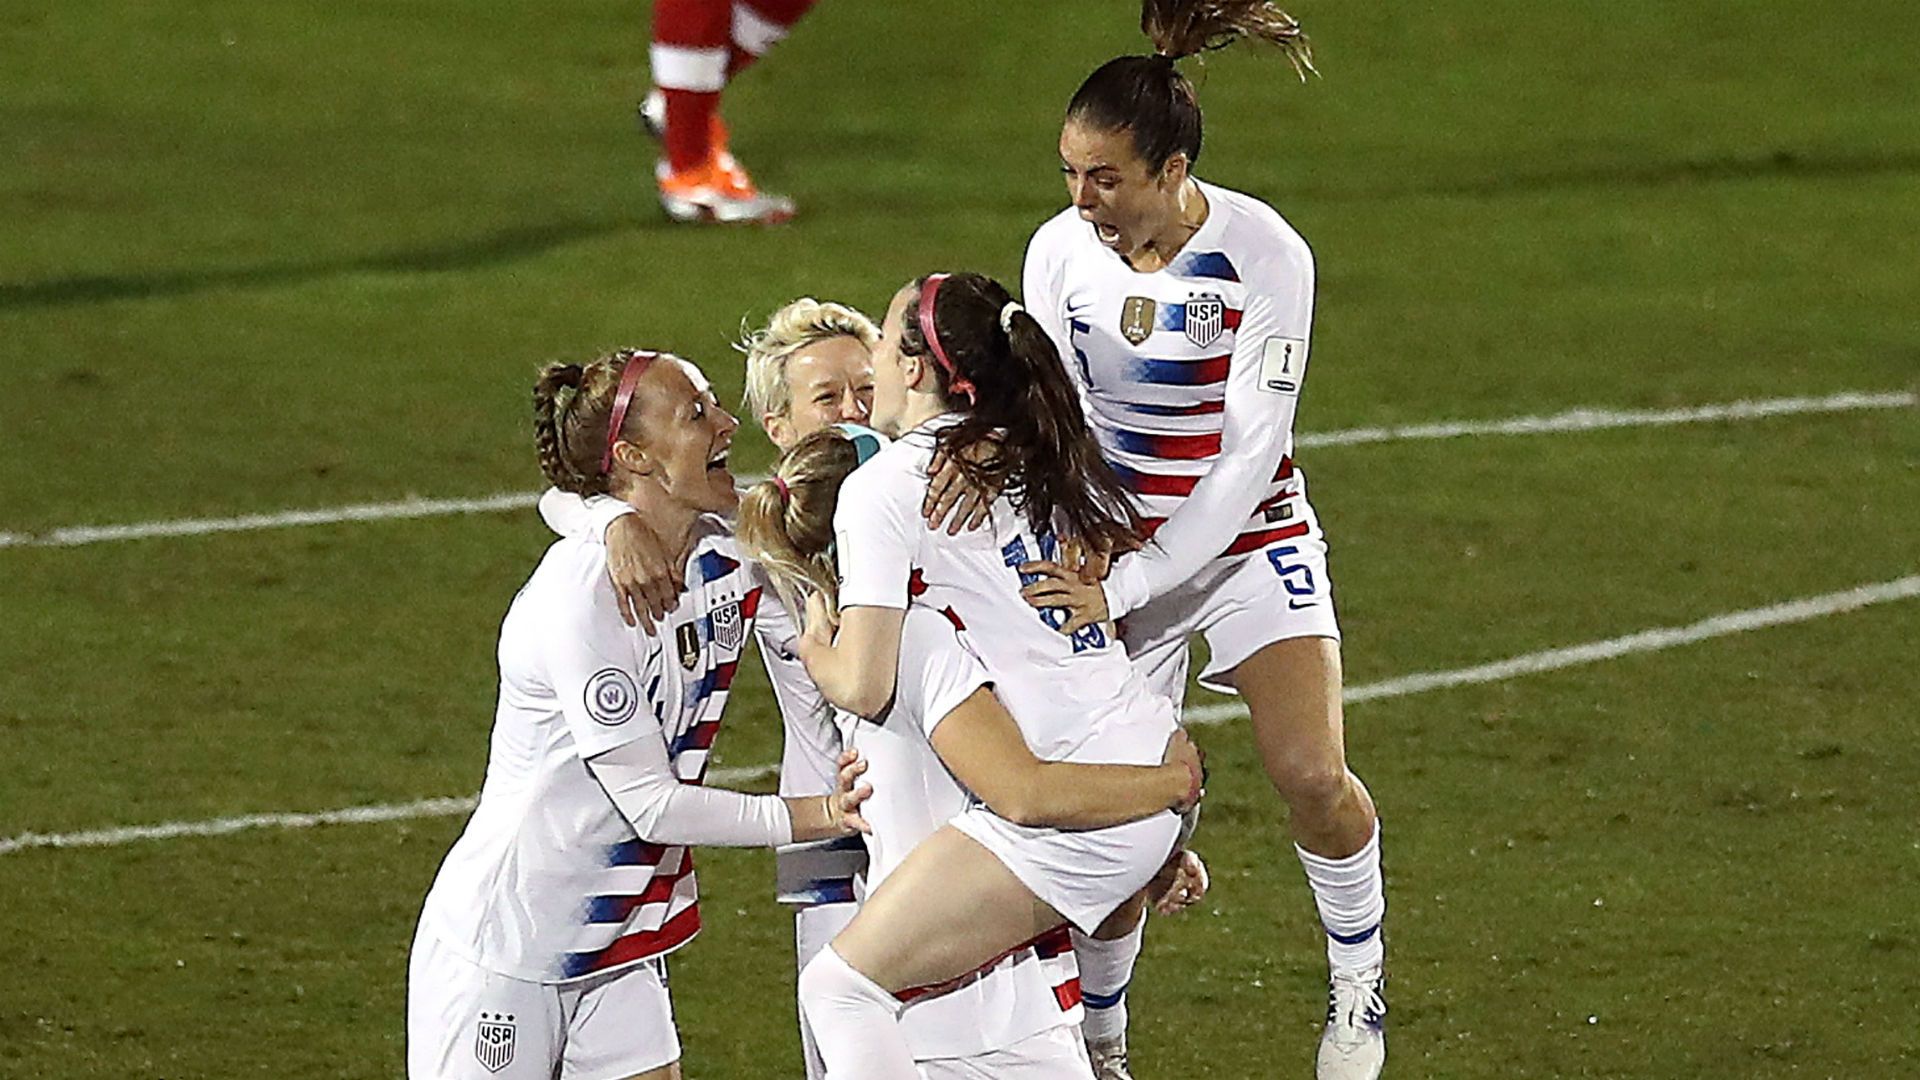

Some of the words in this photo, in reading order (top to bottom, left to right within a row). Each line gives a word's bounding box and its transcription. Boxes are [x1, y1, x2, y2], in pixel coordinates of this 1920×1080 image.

[1189, 304, 1219, 321] USA
[1267, 546, 1315, 595] 5
[714, 605, 737, 624] USA
[481, 1026, 511, 1044] USA
